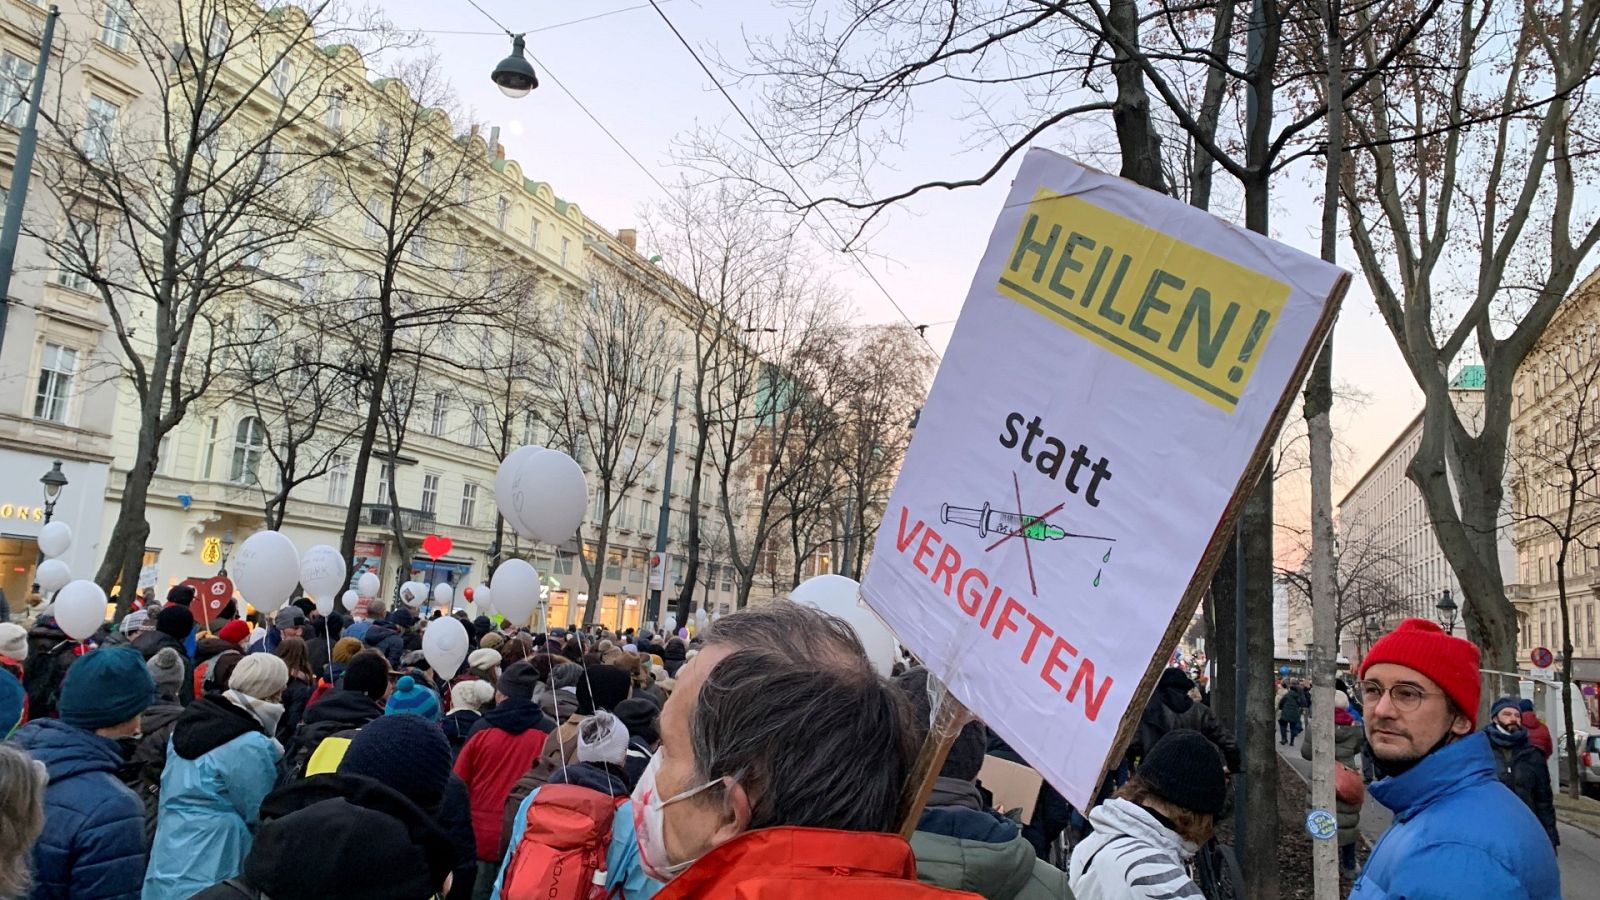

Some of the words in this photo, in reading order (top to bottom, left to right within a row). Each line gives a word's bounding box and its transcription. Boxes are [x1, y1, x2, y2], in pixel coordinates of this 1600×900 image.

[1010, 214, 1272, 384] HEILEN!
[999, 411, 1112, 508] statt
[896, 507, 1114, 723] VERGIFTEN
[548, 857, 564, 900] OVOX
